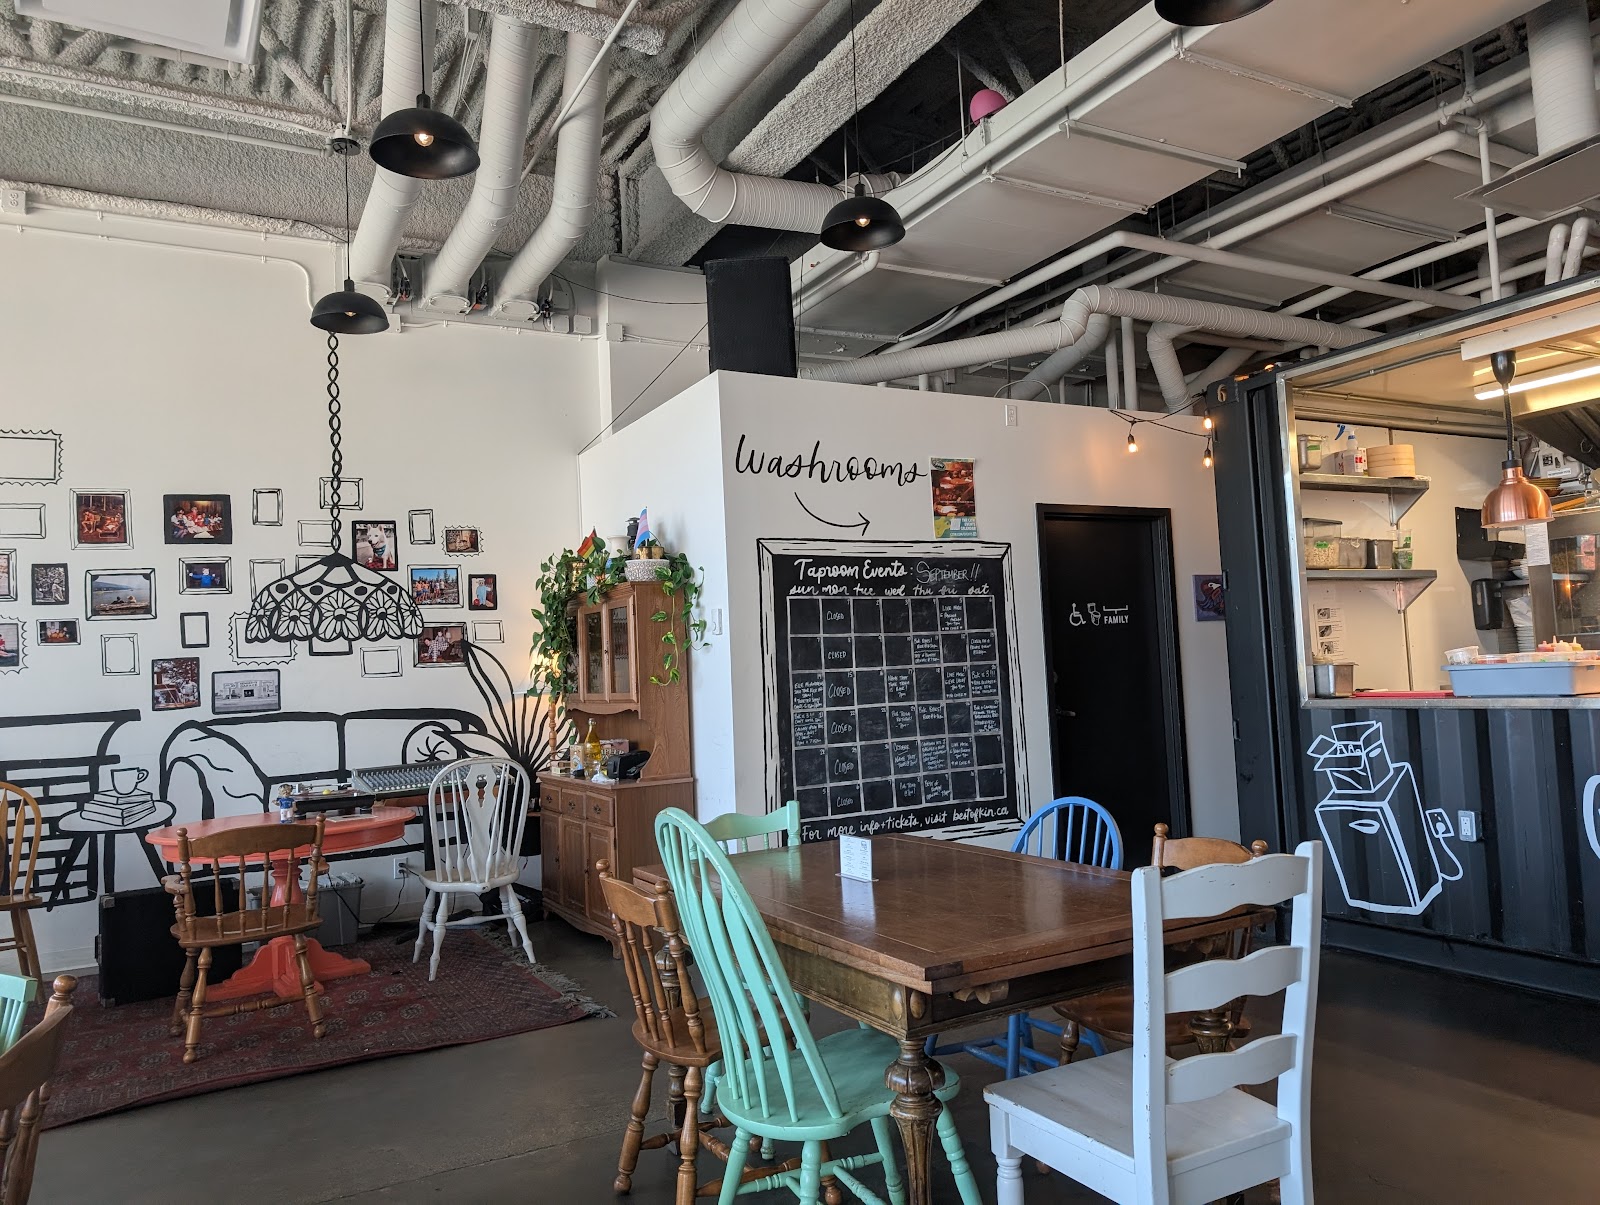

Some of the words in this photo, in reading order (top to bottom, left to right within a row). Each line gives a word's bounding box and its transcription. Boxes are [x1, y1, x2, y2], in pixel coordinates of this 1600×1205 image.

[735, 434, 928, 487] Washrooms
[794, 559, 859, 584] Taproom
[789, 584, 818, 595] sun
[822, 585, 849, 595] mon
[853, 584, 875, 596] tue
[885, 584, 905, 596] wed
[913, 584, 933, 596] thu
[968, 584, 989, 595] sat
[1104, 615, 1129, 624] FAMILY
[802, 825, 823, 842] For
[828, 824, 856, 838] more
[925, 810, 948, 825] visit
[952, 806, 1009, 824] bestofkin.ca
